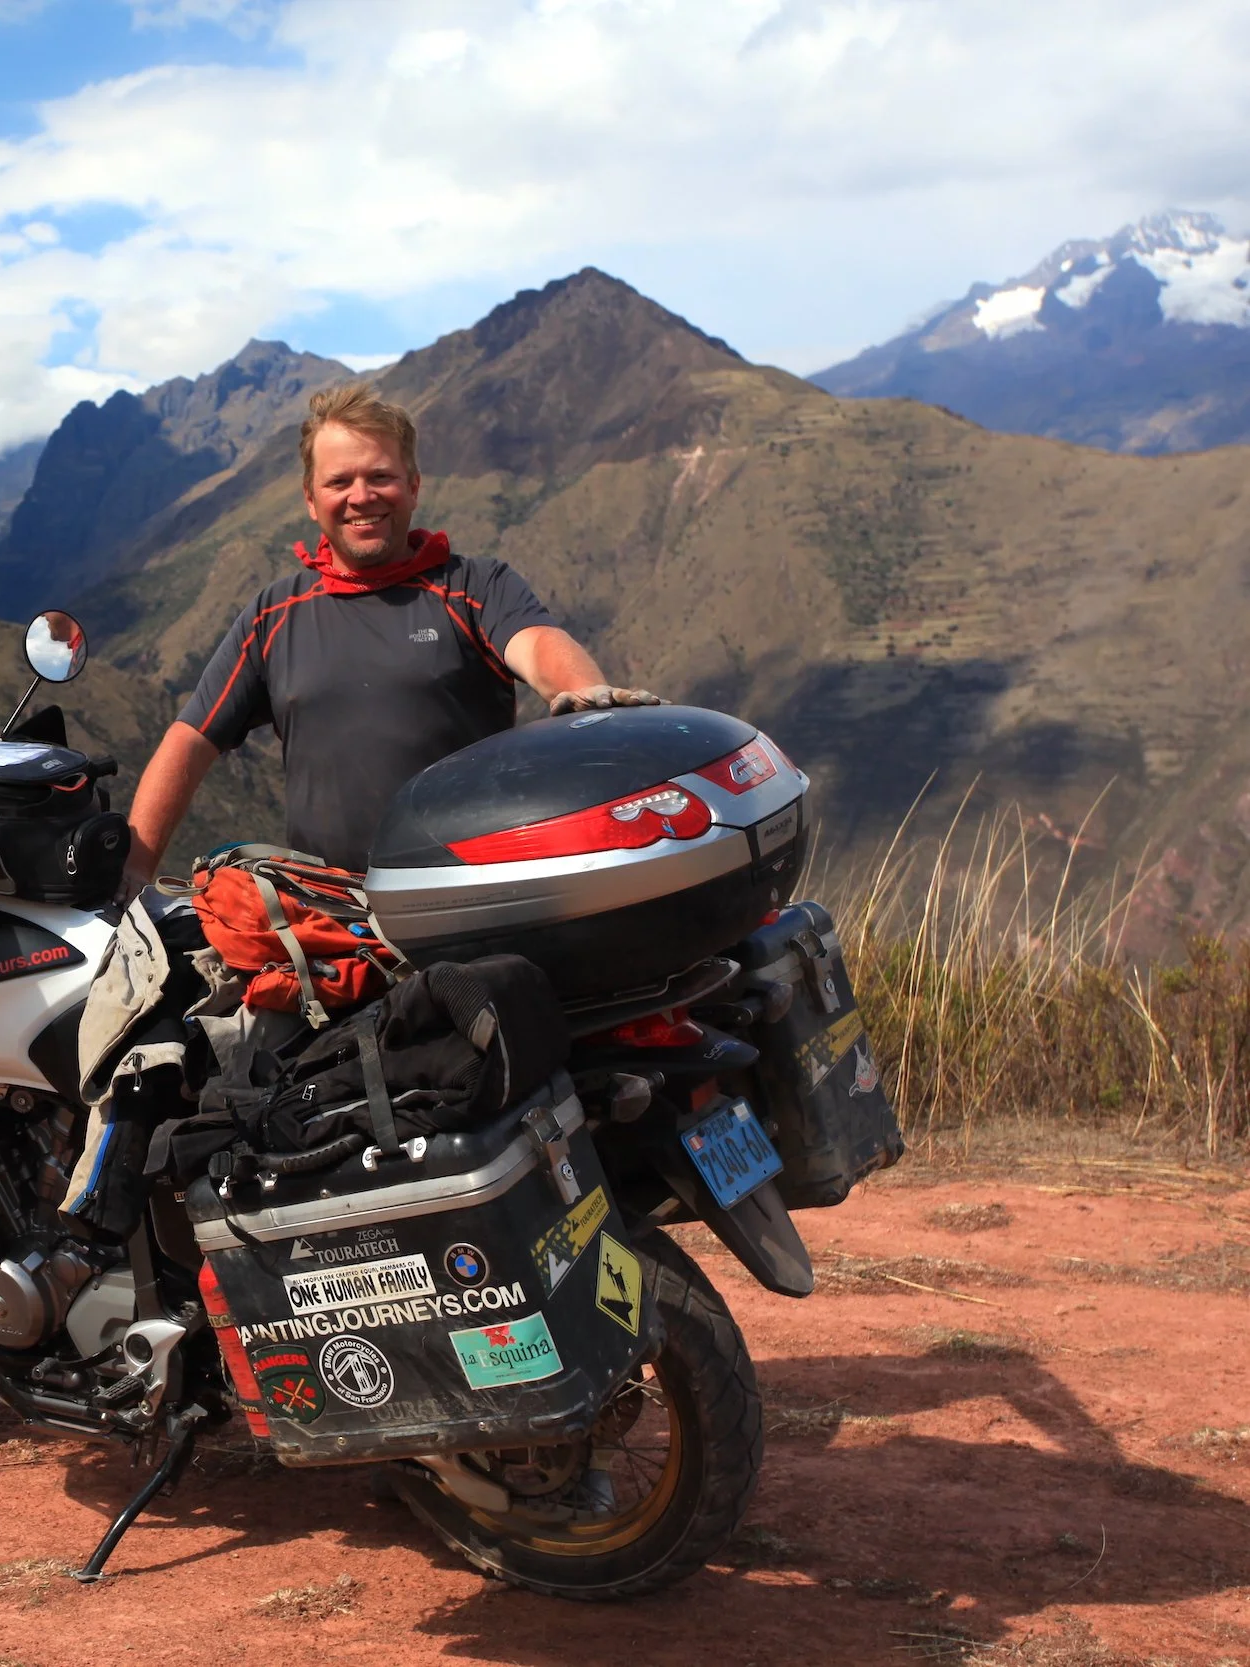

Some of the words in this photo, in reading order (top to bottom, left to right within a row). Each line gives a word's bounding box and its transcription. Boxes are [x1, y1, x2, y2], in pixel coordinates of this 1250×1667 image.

[704, 1114, 735, 1142] PERU
[356, 1228, 384, 1241] ZEGA
[314, 1237, 400, 1265] TOURATECH
[450, 1247, 476, 1259] BMW
[303, 1276, 323, 1284] PEOPLE
[324, 1273, 335, 1281] ARE
[335, 1269, 359, 1279] CREATED
[360, 1266, 379, 1275] EQUAL
[379, 1262, 407, 1271] MEMBERS
[407, 1260, 416, 1268] OF
[290, 1282, 323, 1308] ONE
[321, 1274, 377, 1303] HUMAN
[377, 1266, 429, 1295] FAMILY
[235, 1281, 527, 1347] AINTINGJOURNEYS.COM
[324, 1346, 335, 1369] BMW
[332, 1339, 381, 1364] Motorcycles
[460, 1351, 477, 1366] La
[477, 1337, 554, 1369] Esquina
[344, 1391, 361, 1403] San
[360, 1382, 389, 1404] Francisco
